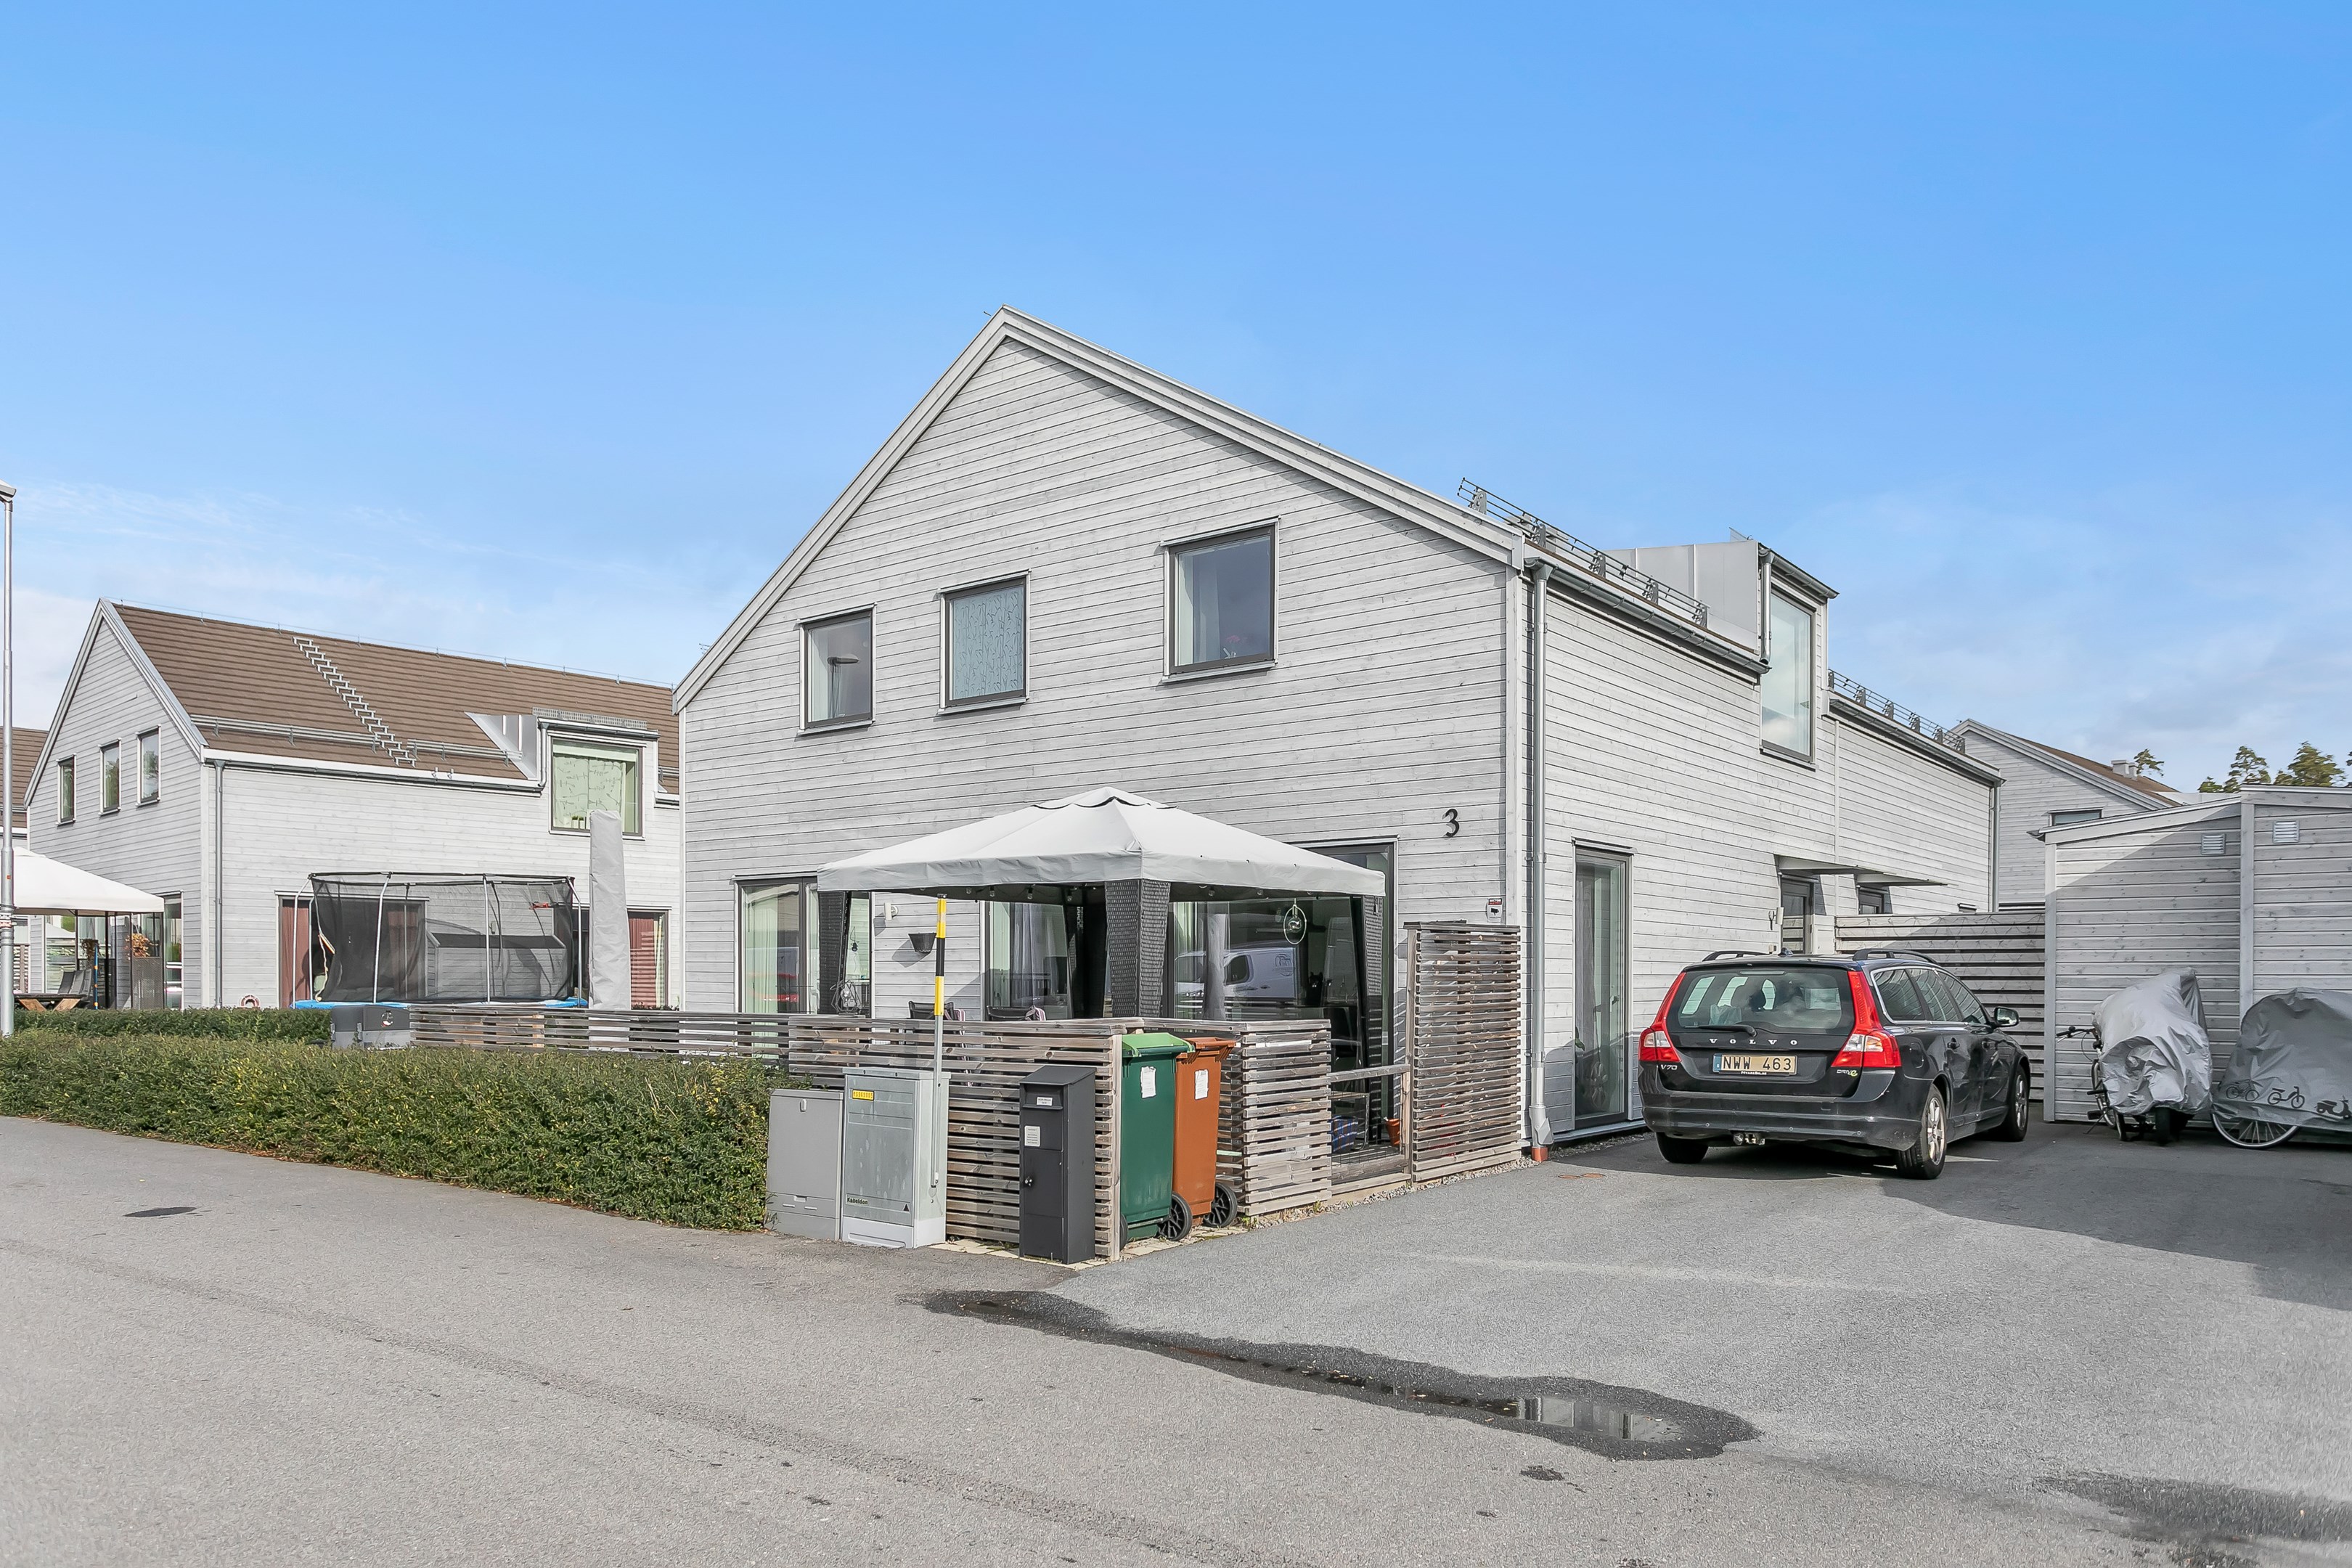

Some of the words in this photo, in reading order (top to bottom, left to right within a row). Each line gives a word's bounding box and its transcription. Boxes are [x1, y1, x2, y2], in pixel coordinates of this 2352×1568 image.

[1445, 808, 1460, 838] 3
[1723, 1056, 1751, 1070] NWW
[1763, 1057, 1792, 1071] 463
